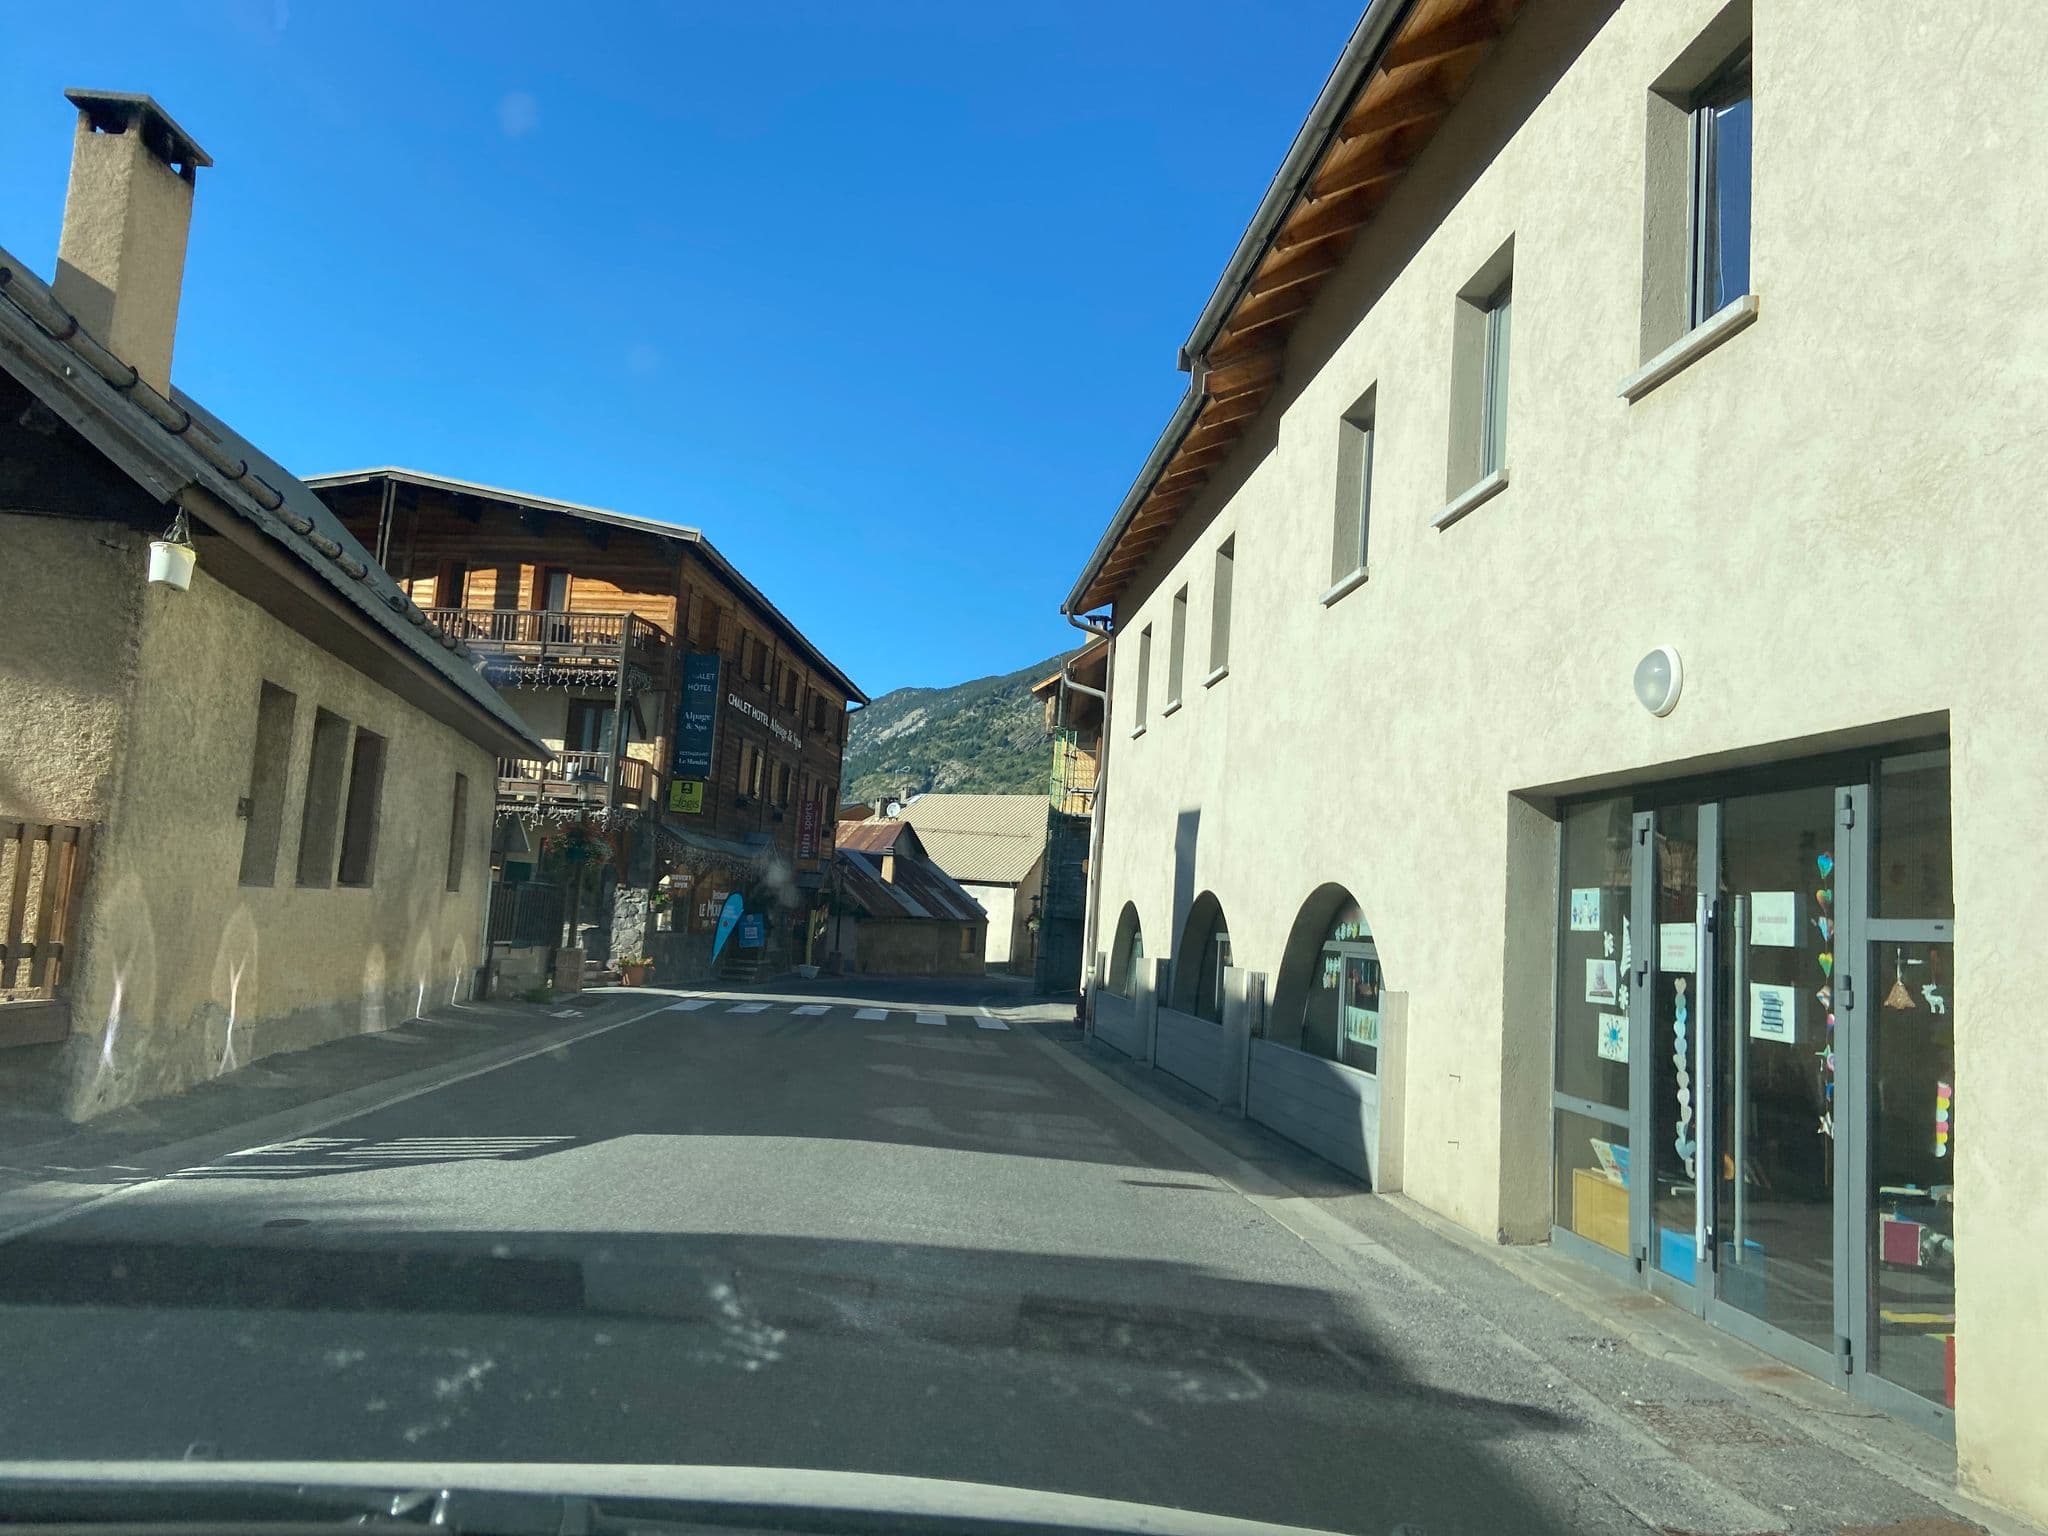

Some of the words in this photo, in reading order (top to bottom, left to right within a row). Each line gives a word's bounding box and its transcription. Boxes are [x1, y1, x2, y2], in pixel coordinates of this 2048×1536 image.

[684, 711, 713, 722] Alpage
[728, 693, 753, 715] CHALET
[769, 717, 788, 742] Alpage
[787, 729, 793, 743] &
[685, 722, 692, 730] &
[694, 723, 708, 732] Spa
